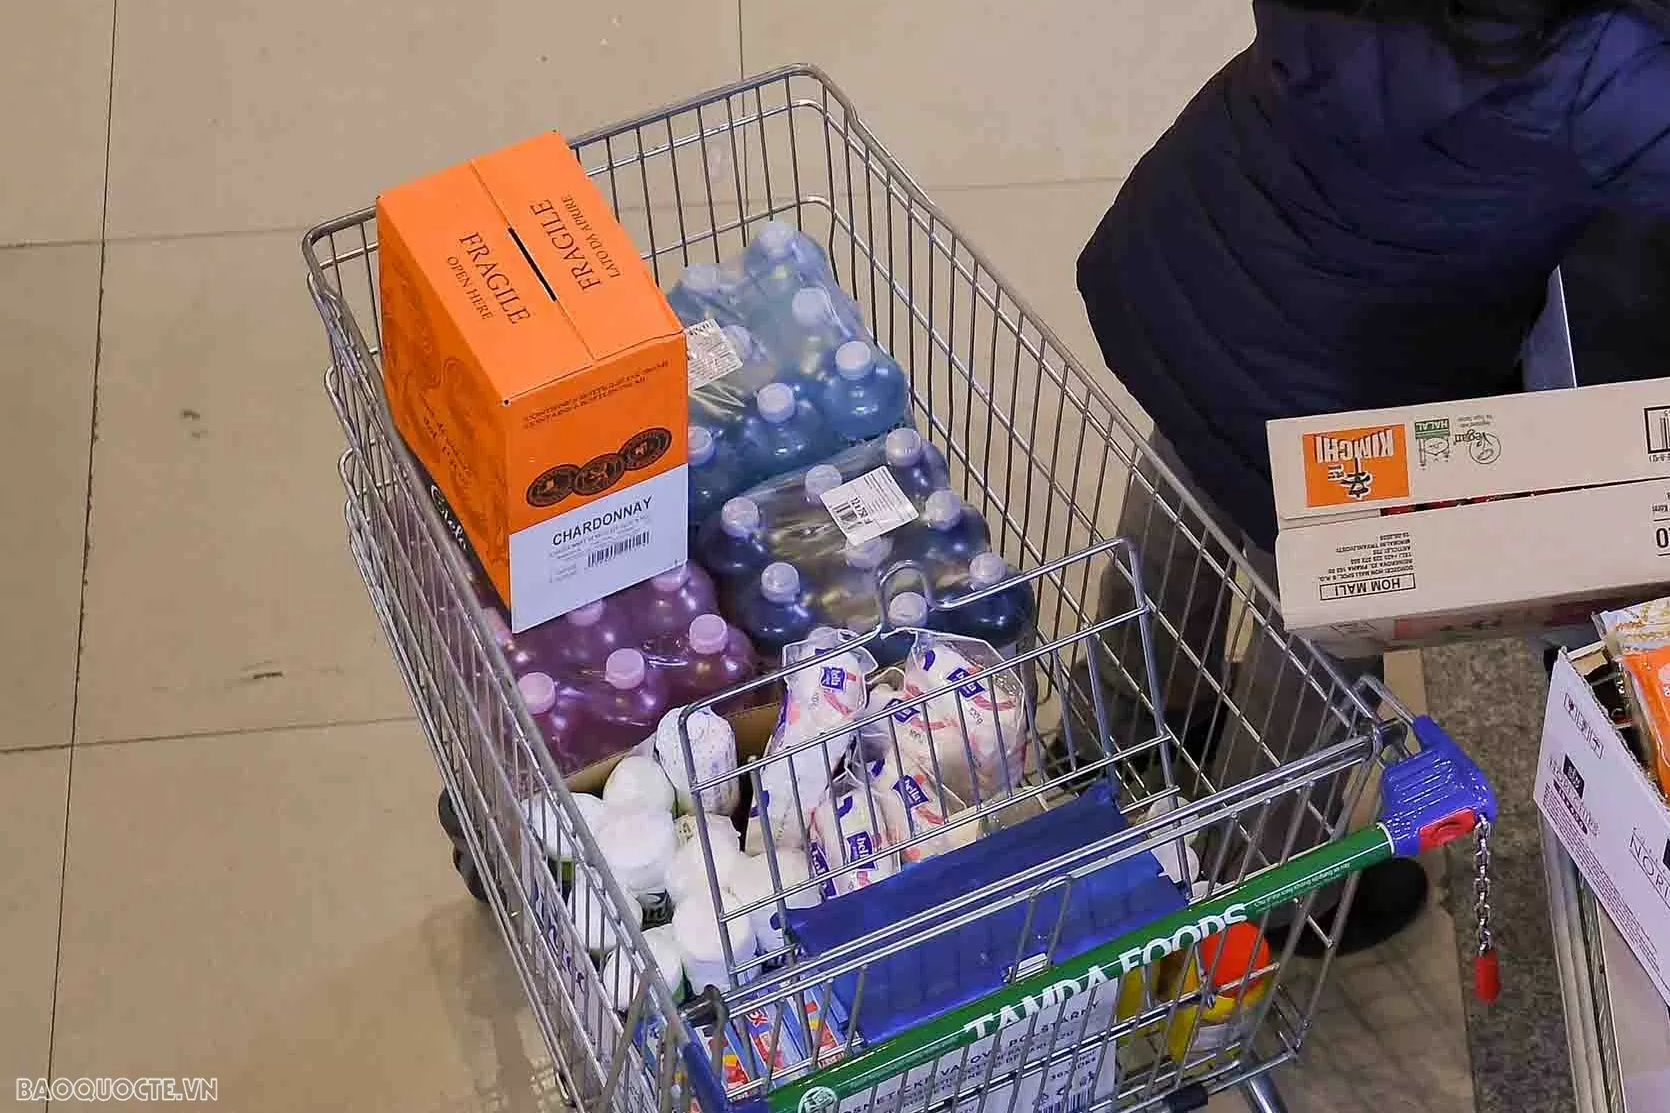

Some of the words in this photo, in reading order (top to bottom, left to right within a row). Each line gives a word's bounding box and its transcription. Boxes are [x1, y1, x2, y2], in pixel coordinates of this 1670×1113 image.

[530, 199, 601, 291] FRAGILE
[447, 256, 471, 288] OPEN
[466, 288, 493, 320] HERE
[459, 231, 531, 325] FRAGILE
[1313, 428, 1394, 464] KIMCHI
[1415, 419, 1449, 432] HALAL
[552, 494, 653, 546] CHARDONNAY
[1335, 582, 1367, 597] MALI
[1371, 578, 1401, 592] HOM
[1630, 834, 1670, 899] NORI
[963, 964, 1110, 1039] TAMDA
[1119, 902, 1249, 974] FOODS
